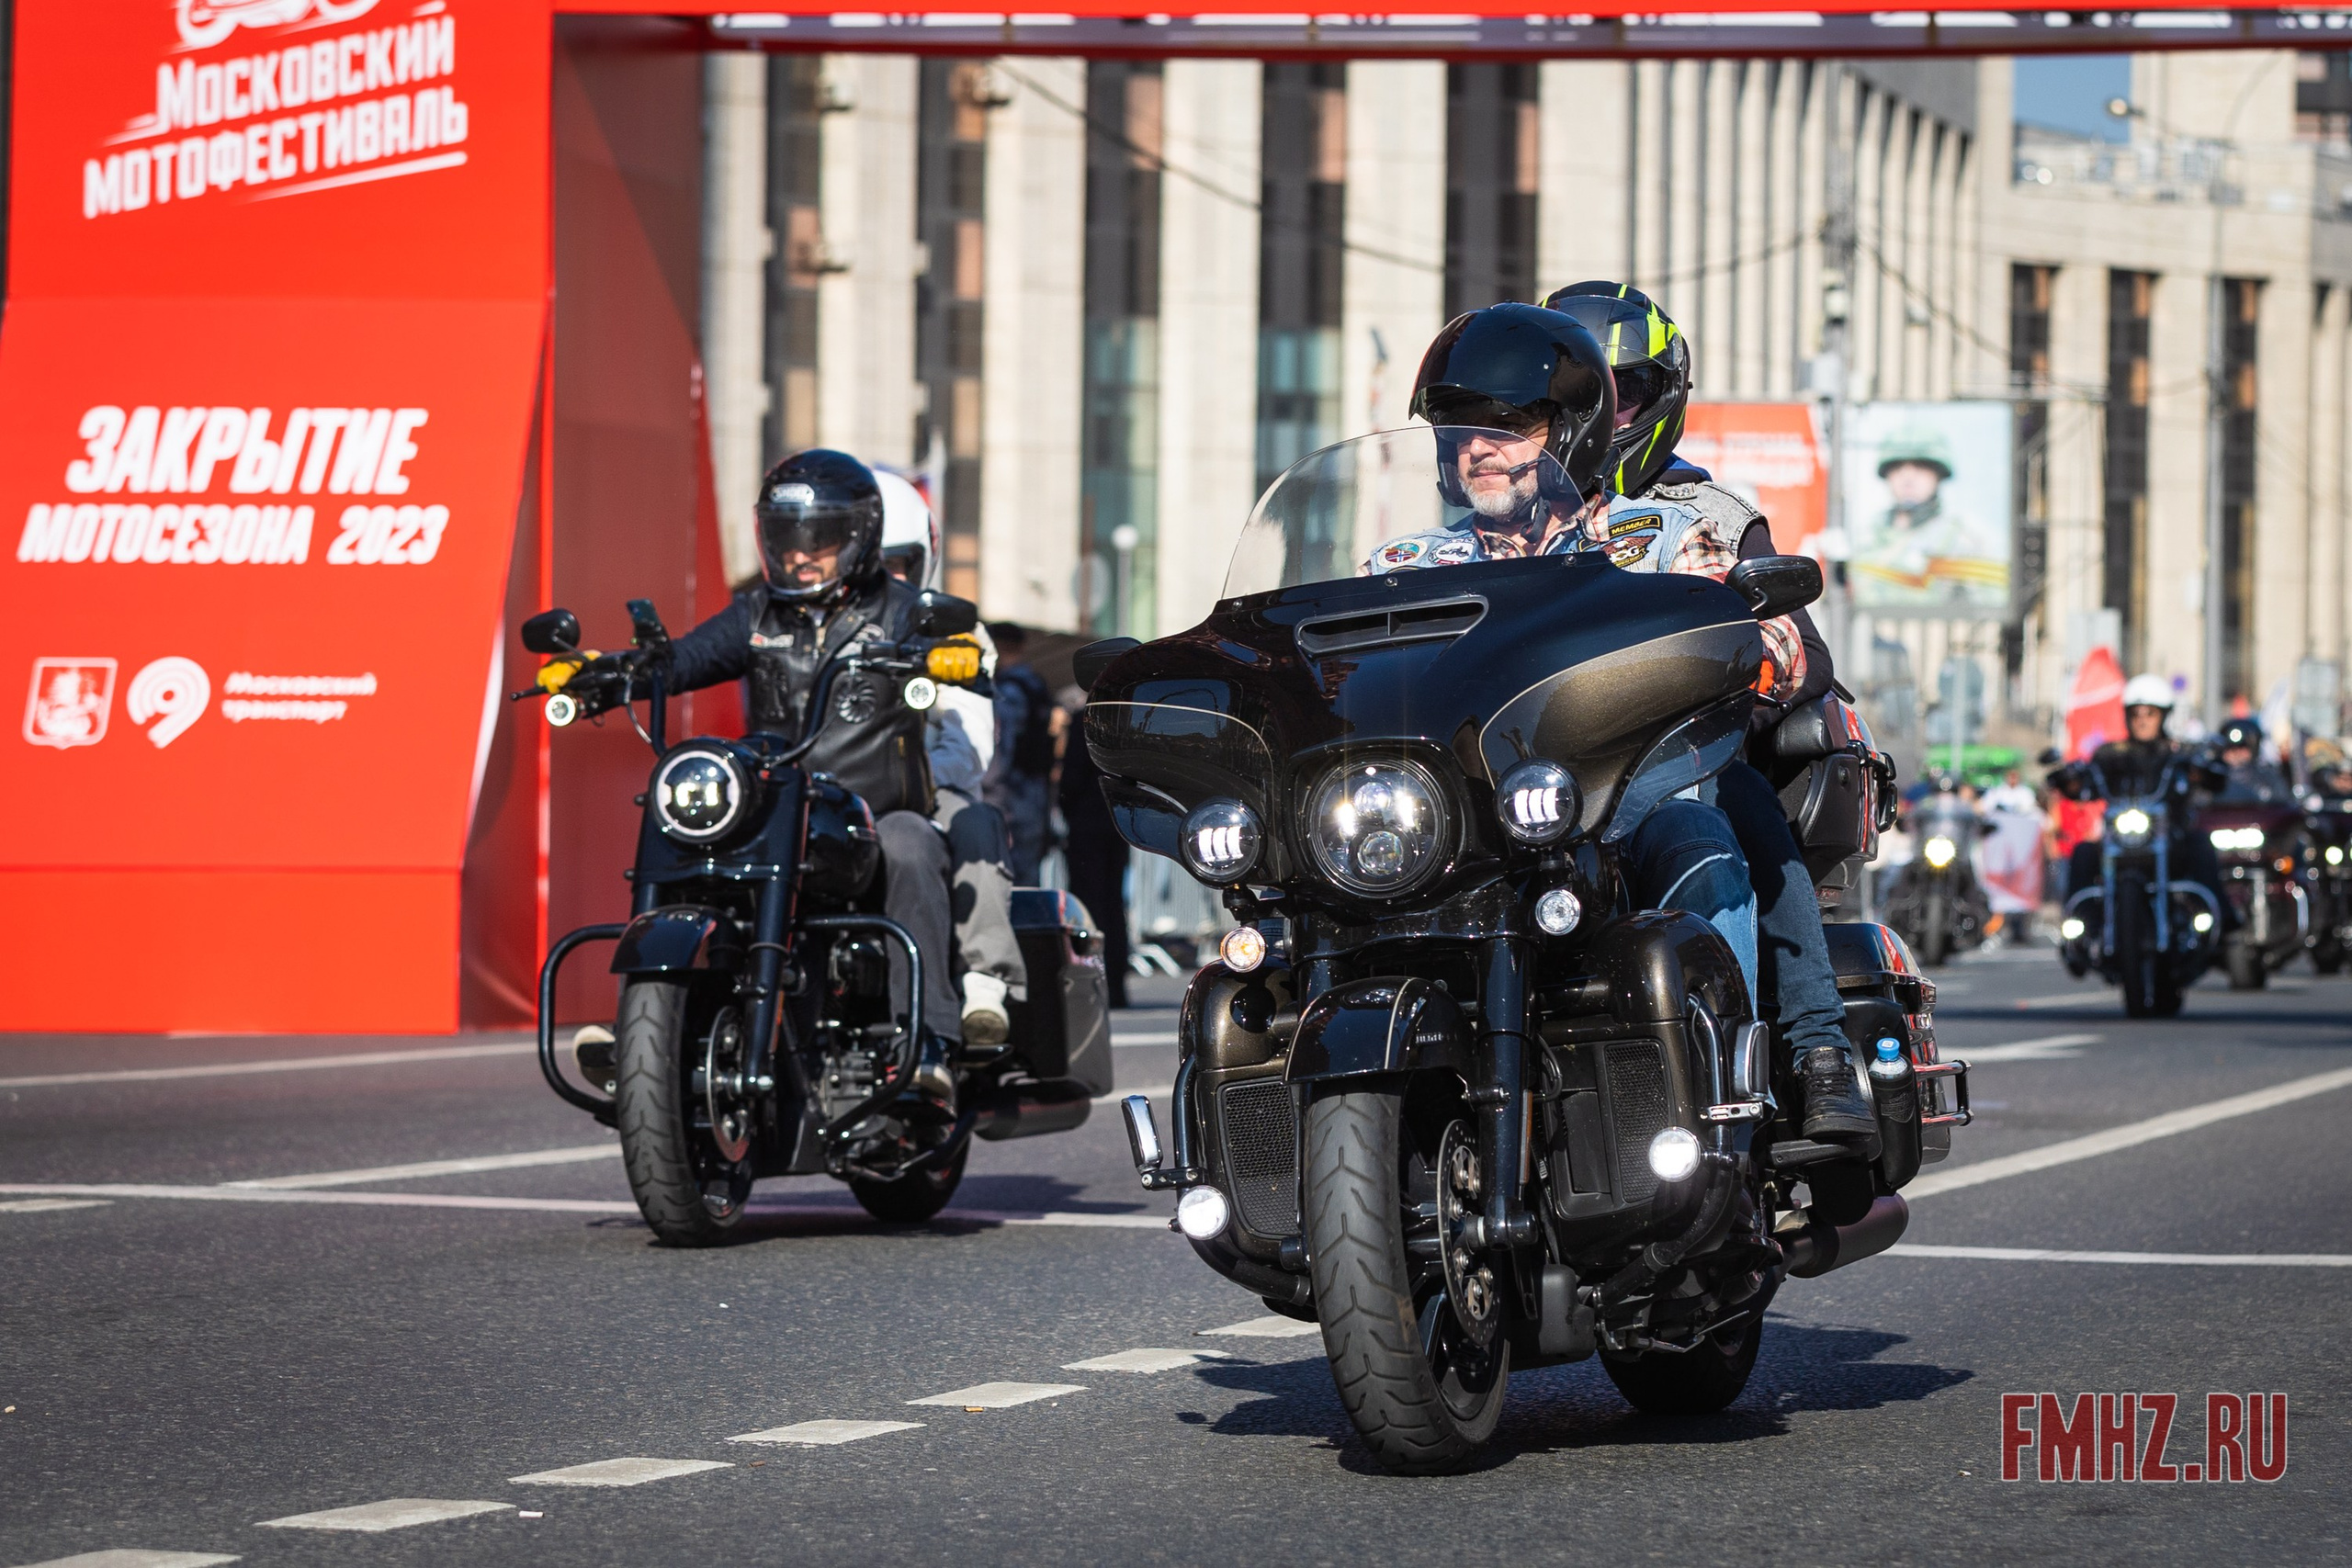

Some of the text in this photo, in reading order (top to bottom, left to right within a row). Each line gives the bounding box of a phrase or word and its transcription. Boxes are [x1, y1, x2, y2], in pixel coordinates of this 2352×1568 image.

[83, 86, 469, 220] МОТОФЕСТИВАЛЬ
[65, 405, 429, 494] ЗАКРЫТИЕ
[17, 503, 450, 565] МОТОСЕЗОНА 2023
[1611, 518, 1652, 535] MEMBER
